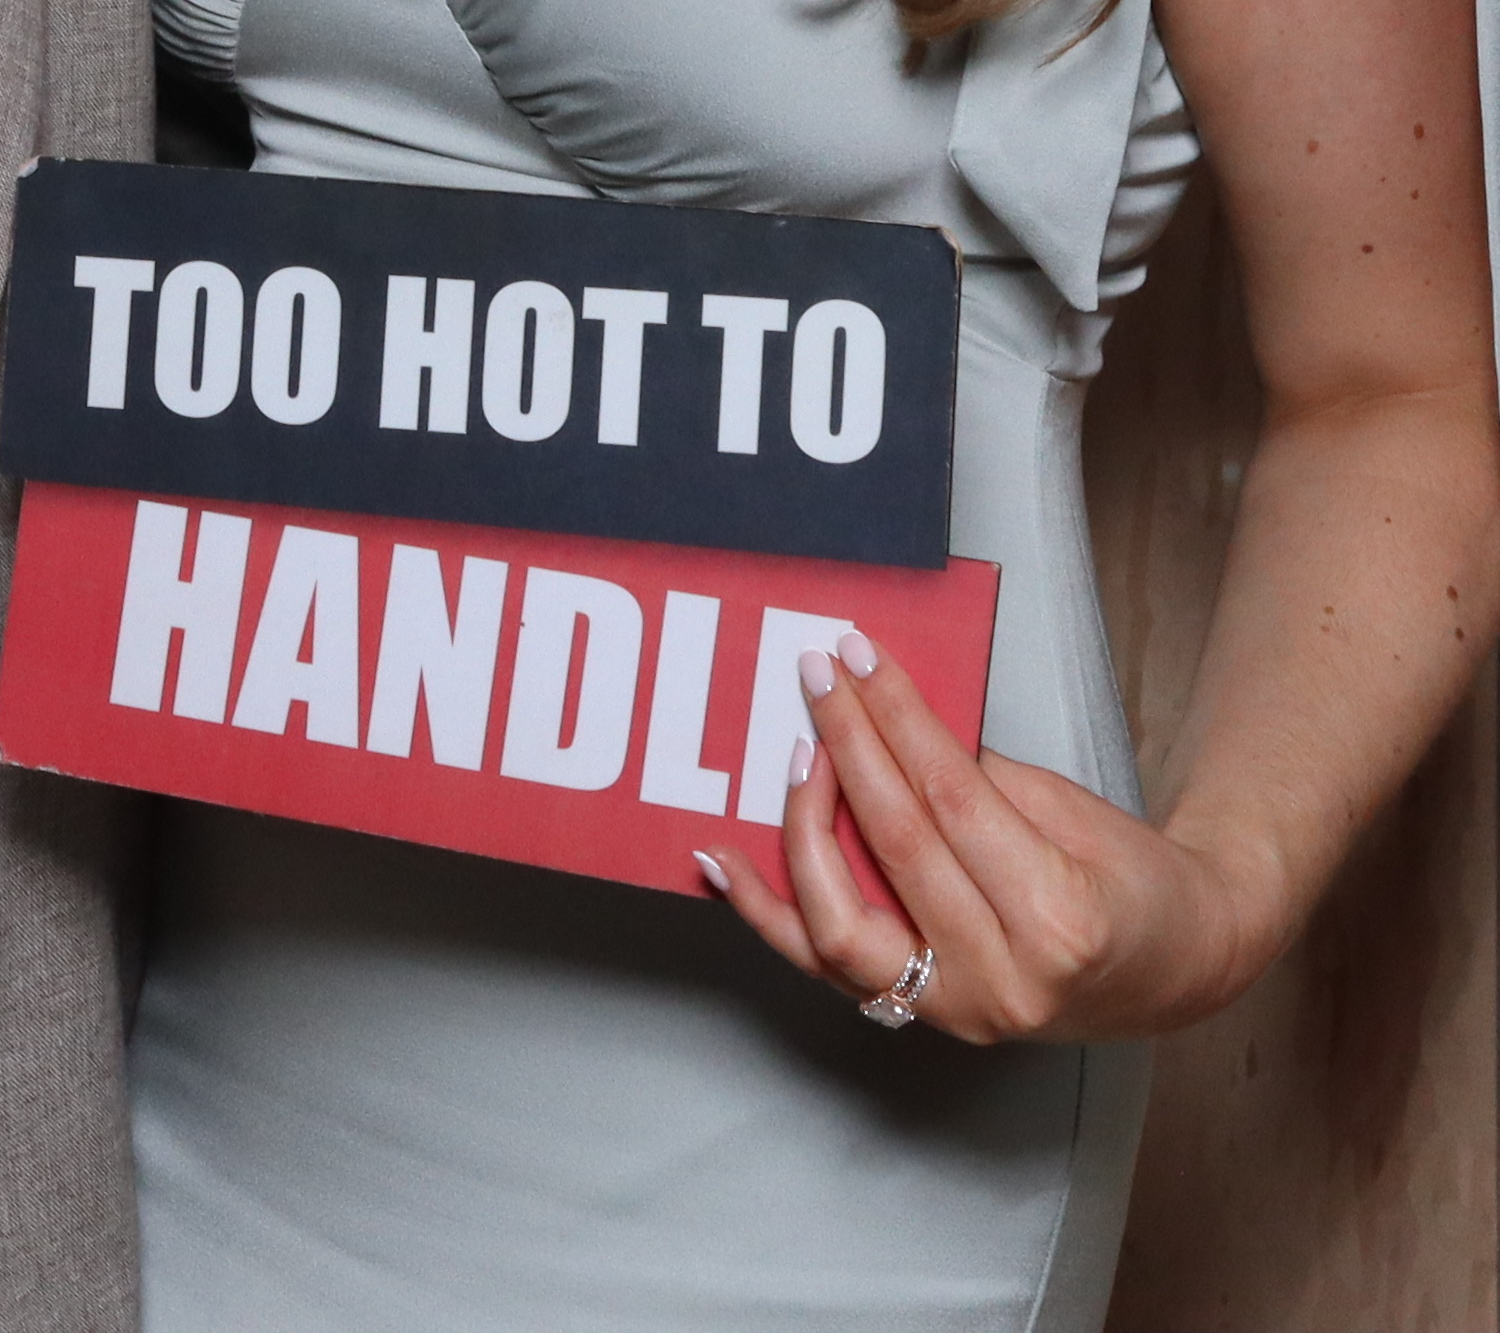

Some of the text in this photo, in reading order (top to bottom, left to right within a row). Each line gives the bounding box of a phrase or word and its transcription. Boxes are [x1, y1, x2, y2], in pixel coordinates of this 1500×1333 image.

[73, 254, 887, 466] TOO HOT TO
